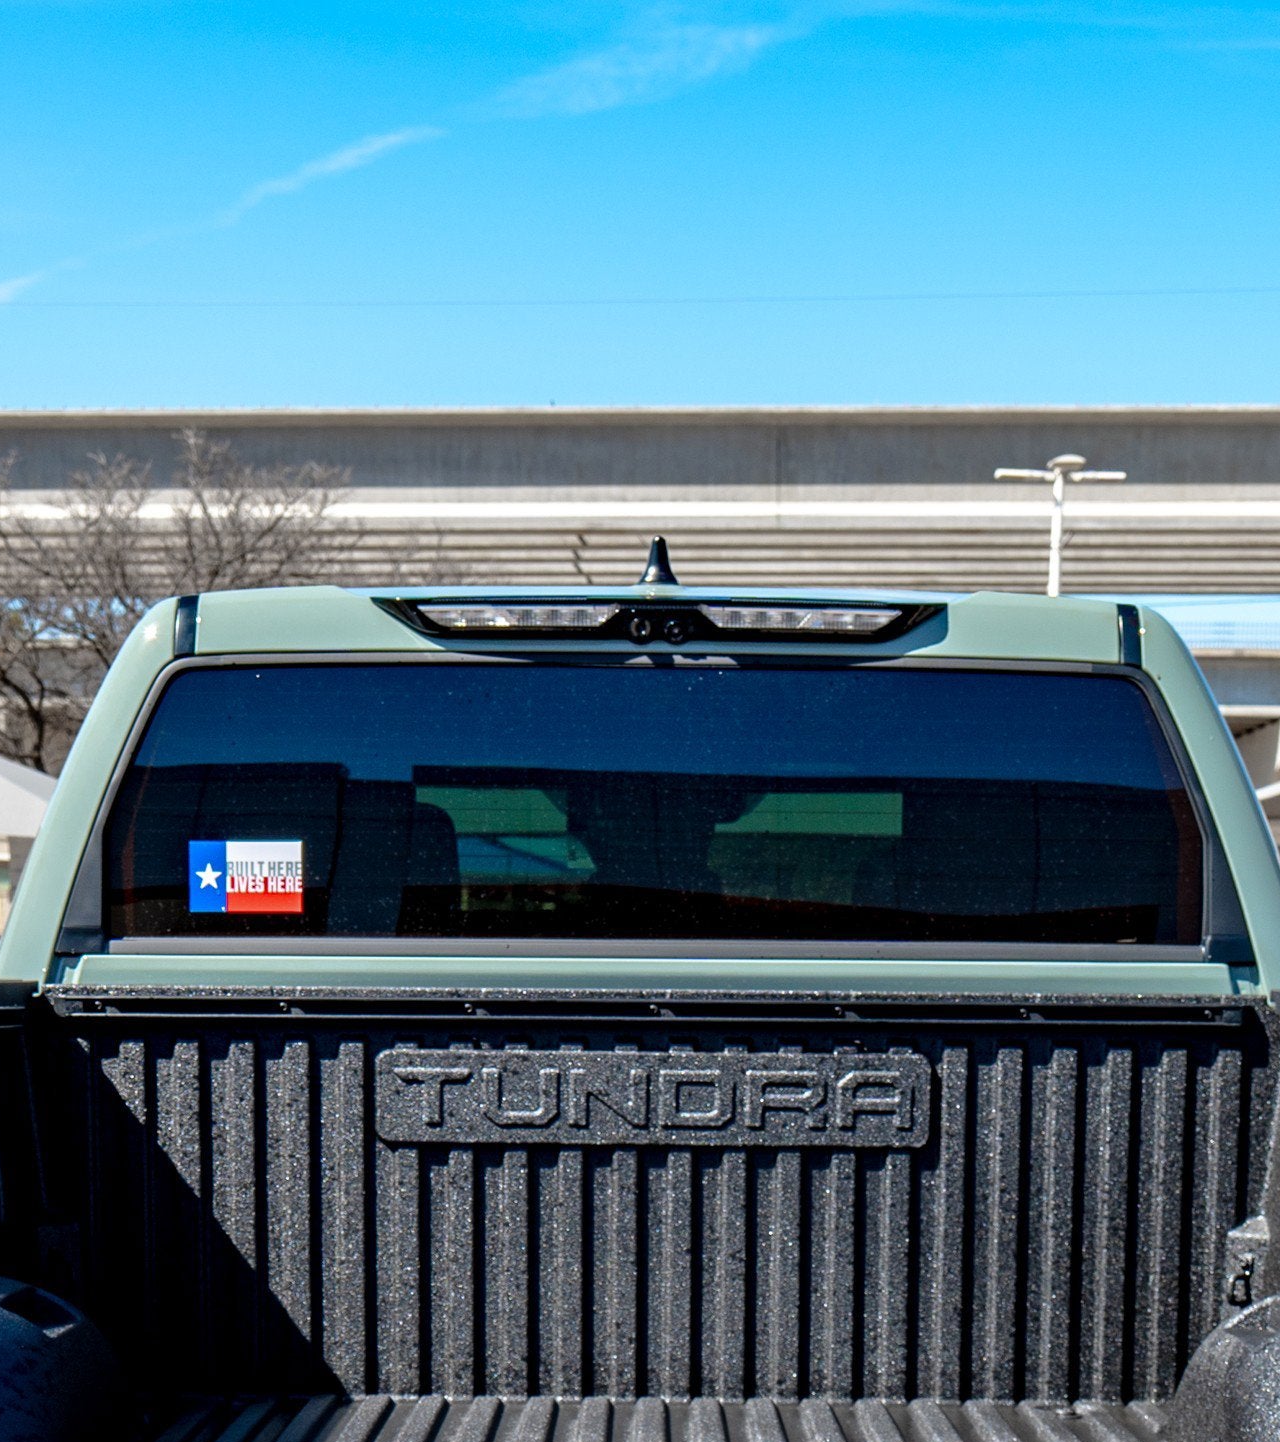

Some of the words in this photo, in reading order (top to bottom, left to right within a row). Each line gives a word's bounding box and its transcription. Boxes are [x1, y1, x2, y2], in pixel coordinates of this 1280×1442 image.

[227, 861, 265, 877] BUILT
[268, 861, 302, 876] HERE
[226, 876, 265, 893] LIVES
[268, 876, 303, 893] HERE
[393, 1067, 914, 1129] TUNDRA
